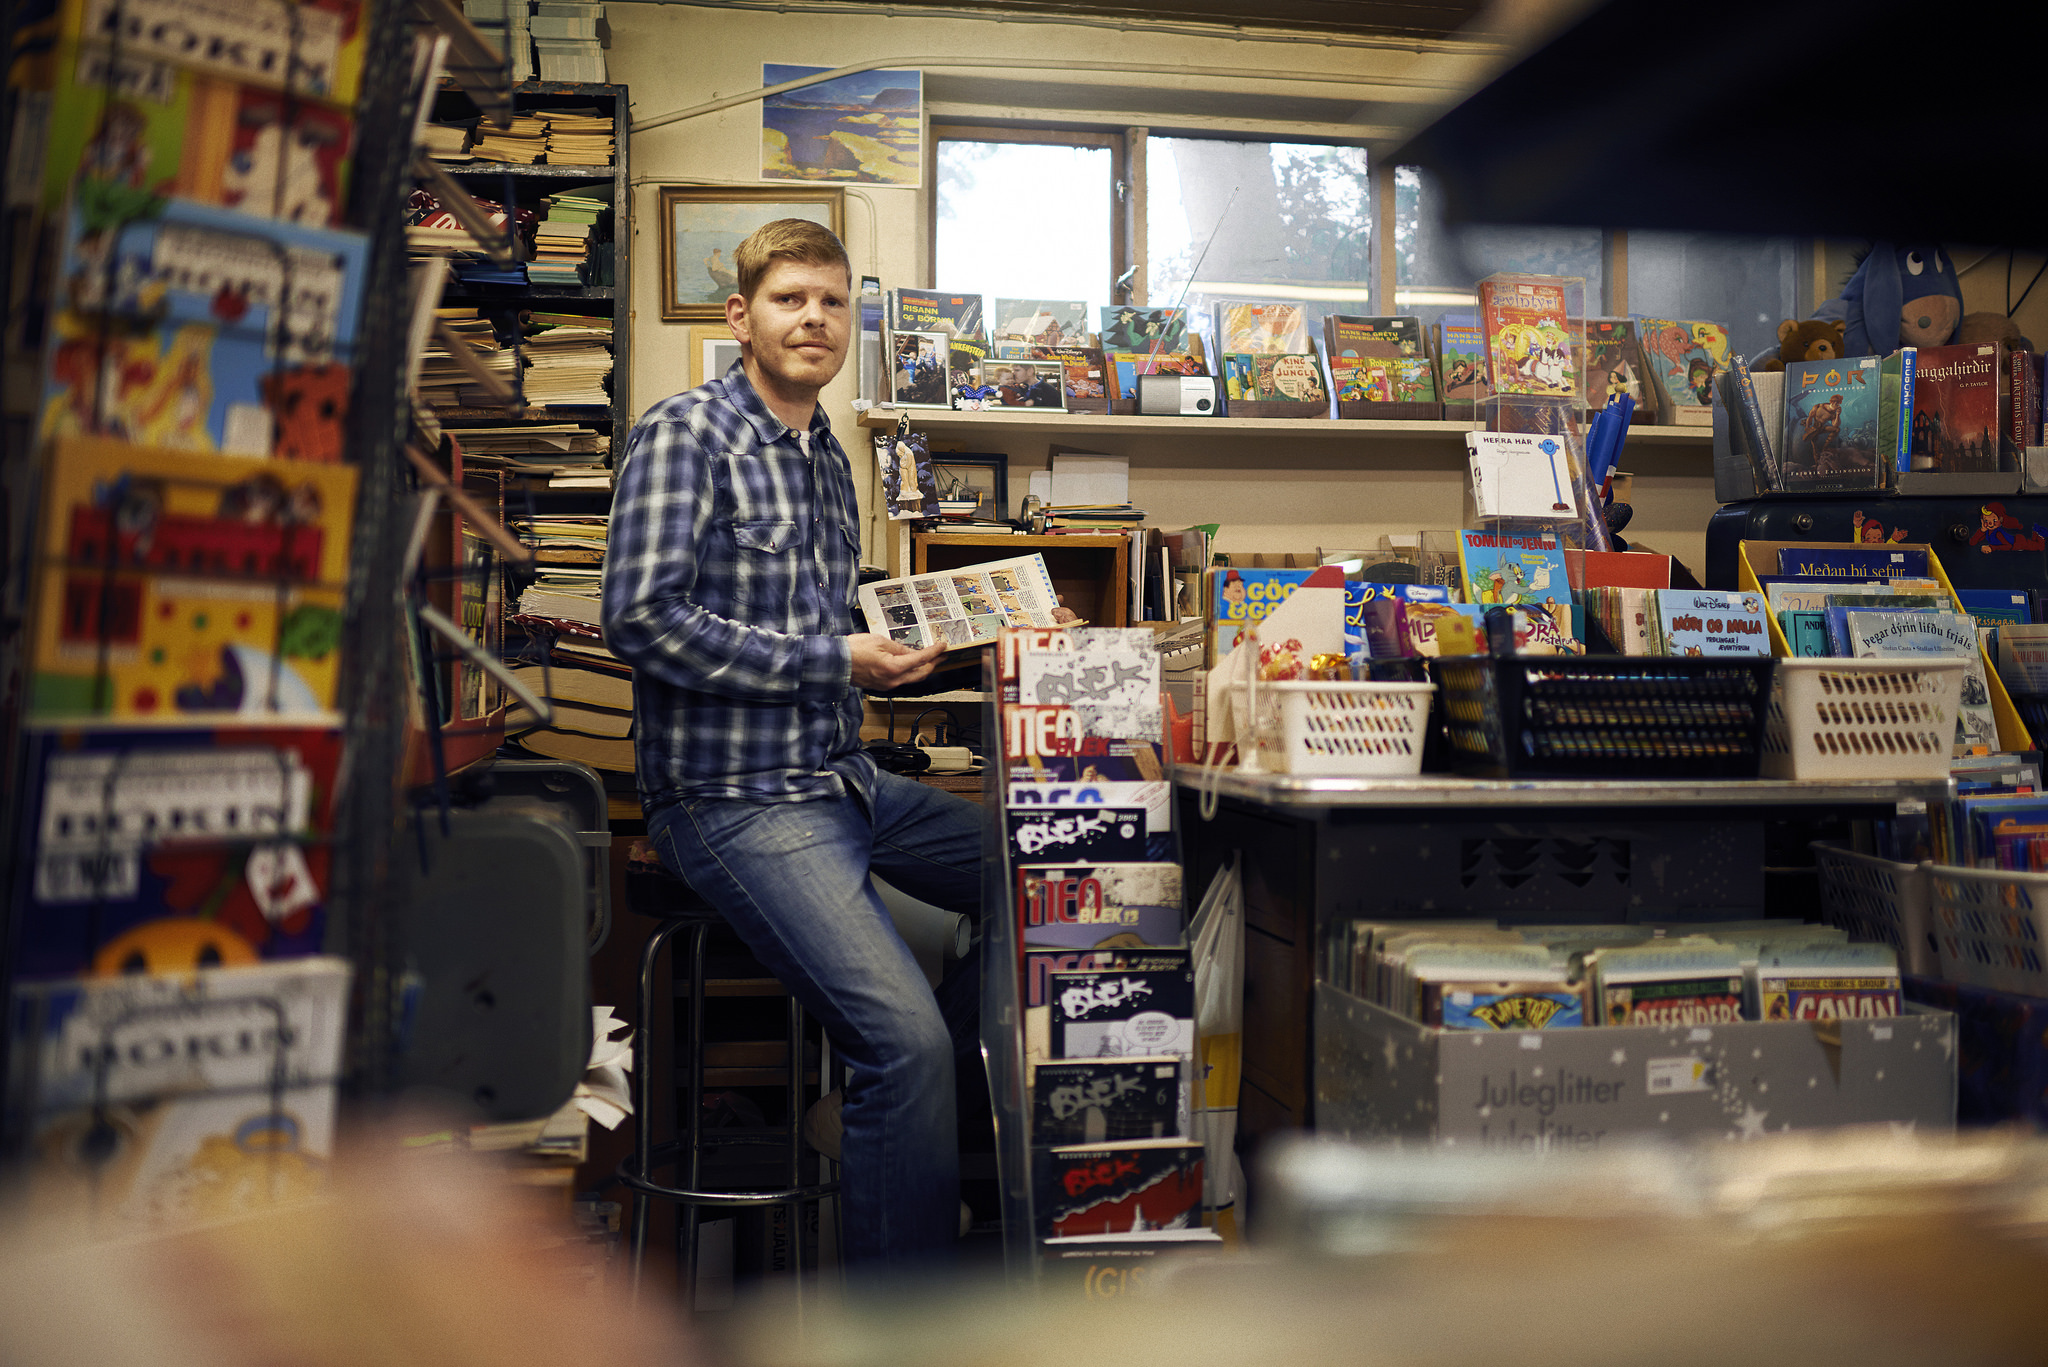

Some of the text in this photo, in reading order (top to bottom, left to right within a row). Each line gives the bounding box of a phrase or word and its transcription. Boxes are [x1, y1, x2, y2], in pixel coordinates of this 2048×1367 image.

[902, 305, 938, 315] RISANN
[917, 314, 954, 324] BÖRNIN
[951, 342, 986, 358] ANKENSTEIN
[1276, 368, 1315, 377] JUNGLE
[1369, 359, 1414, 369] Robin Hood
[1915, 360, 1992, 383] kuggahirðir
[2013, 378, 2023, 446] ARTEMIS FOWL
[1465, 534, 1512, 549] TOMMI
[1521, 537, 1556, 551] JENNI
[1800, 563, 1846, 576] Meðan
[1872, 564, 1905, 577] sefur
[1247, 578, 1299, 600] GÖG
[1672, 613, 1762, 634] MÓRI OG MALLA
[1804, 621, 1826, 630] ANDR
[1862, 622, 1973, 650] þegar dýrin lifðu frjáls
[1118, 814, 1139, 822] 2005
[1078, 907, 1123, 924] BLEK
[1823, 980, 1855, 988] COMICS
[1858, 979, 1886, 988] GROUP
[1634, 1003, 1745, 1027] DEFENDERS
[1156, 1088, 1167, 1106] 6
[1475, 1067, 1625, 1116] Juleglitter
